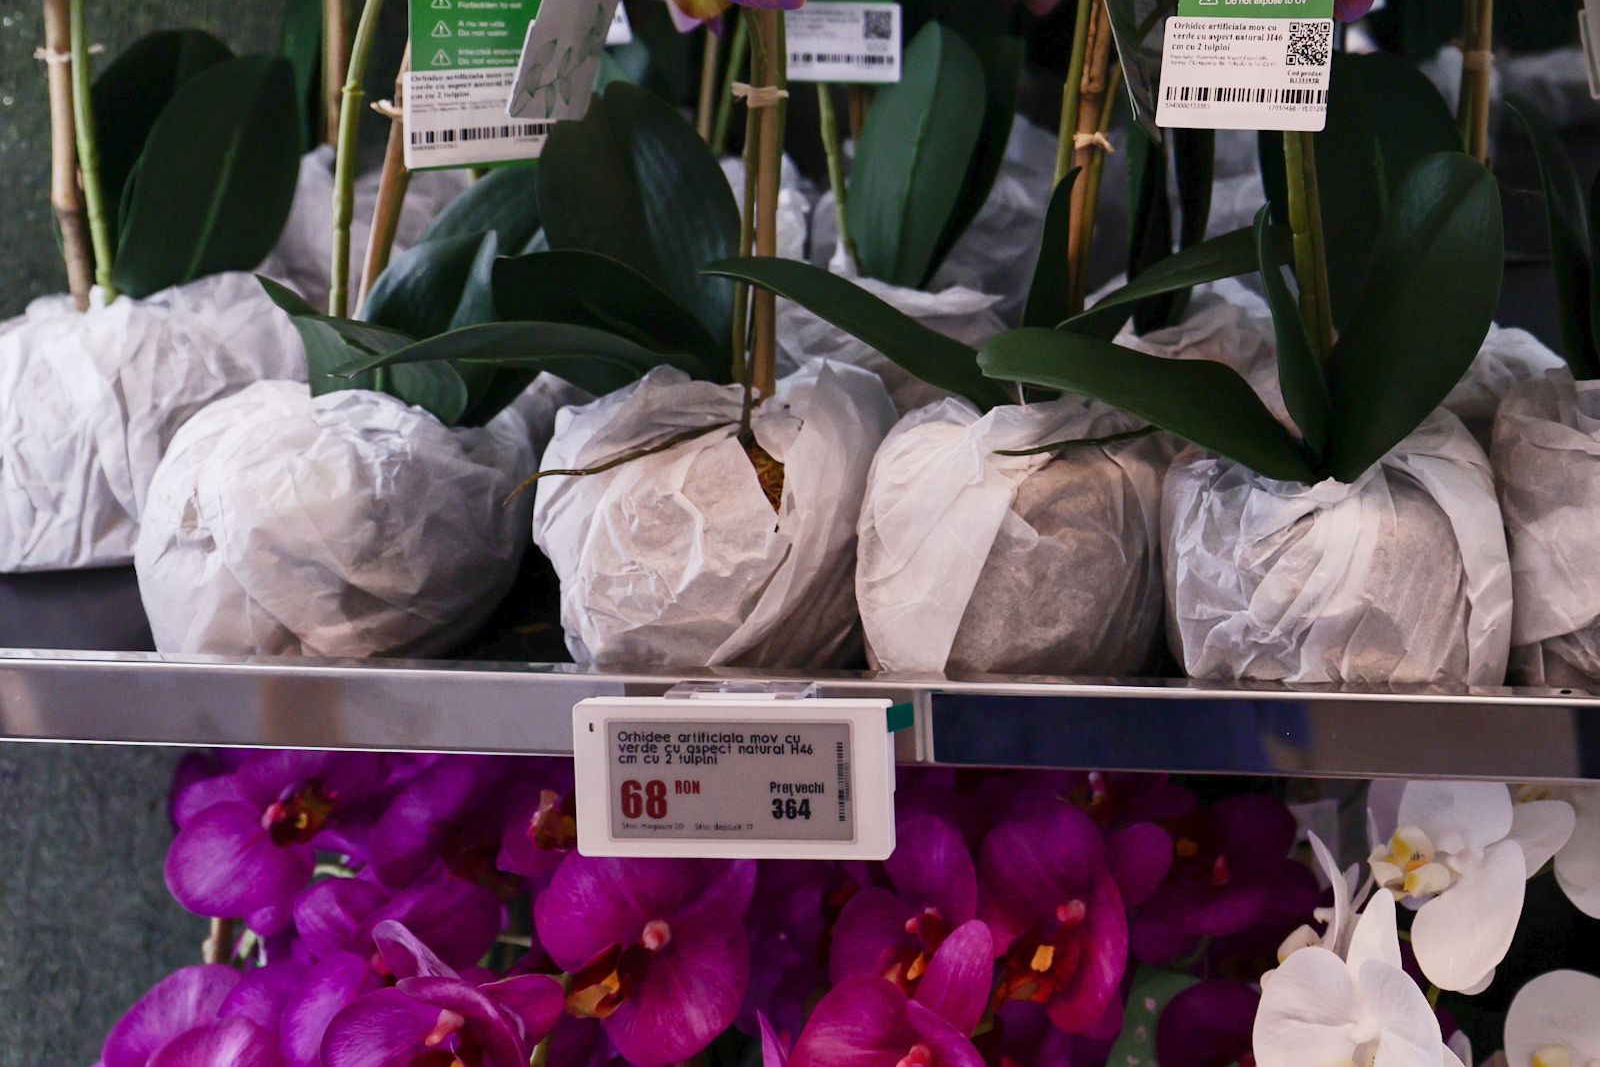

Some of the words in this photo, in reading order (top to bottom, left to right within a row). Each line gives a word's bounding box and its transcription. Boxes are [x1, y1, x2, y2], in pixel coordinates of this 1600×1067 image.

[1208, 22, 1247, 31] artificiala
[1173, 32, 1195, 40] verde
[1208, 33, 1233, 42] aspect
[1235, 33, 1264, 41] natural
[1197, 42, 1202, 50] 2
[1204, 43, 1231, 52] tulpini
[617, 731, 671, 743] Orhidee
[677, 731, 744, 744] artificiala
[750, 734, 778, 744] mov
[785, 734, 801, 744] cu
[618, 742, 658, 753] verde
[664, 744, 681, 754] cu
[686, 744, 732, 756] aspect
[738, 743, 785, 755] natural
[791, 744, 814, 755] H46
[618, 754, 637, 764] cm
[643, 754, 660, 764] cu
[665, 753, 672, 764] 2
[678, 752, 718, 766] tulpini
[795, 781, 825, 794] vechi
[621, 779, 667, 819] 68
[674, 779, 700, 794] RON
[771, 798, 812, 820] 364
[622, 822, 639, 830] Stoc
[694, 822, 711, 831] Stoc
